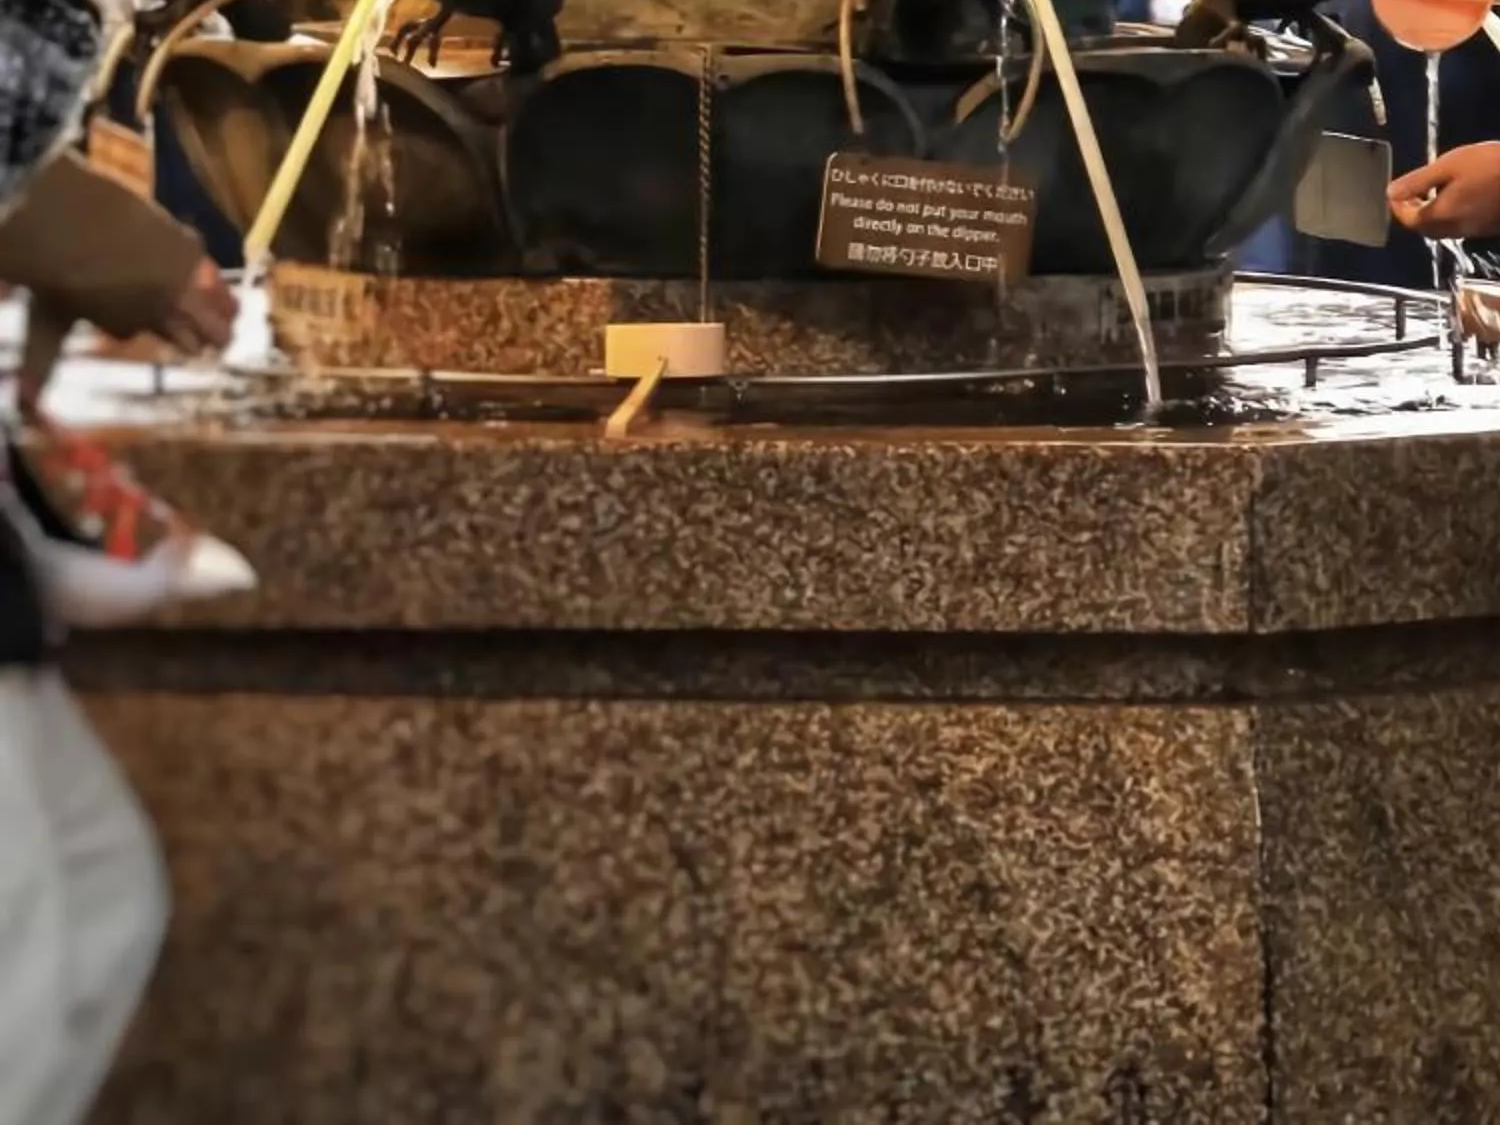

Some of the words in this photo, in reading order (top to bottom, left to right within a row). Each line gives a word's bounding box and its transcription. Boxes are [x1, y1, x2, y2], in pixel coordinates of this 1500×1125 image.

[831, 192, 873, 210] Please
[875, 198, 895, 212] do
[896, 202, 920, 215] not
[922, 203, 947, 218] put
[948, 207, 980, 222] your
[983, 210, 1028, 226] mouth
[852, 216, 902, 235] directly
[906, 223, 925, 234] on
[927, 223, 950, 237] the
[952, 226, 999, 242] dipper.
